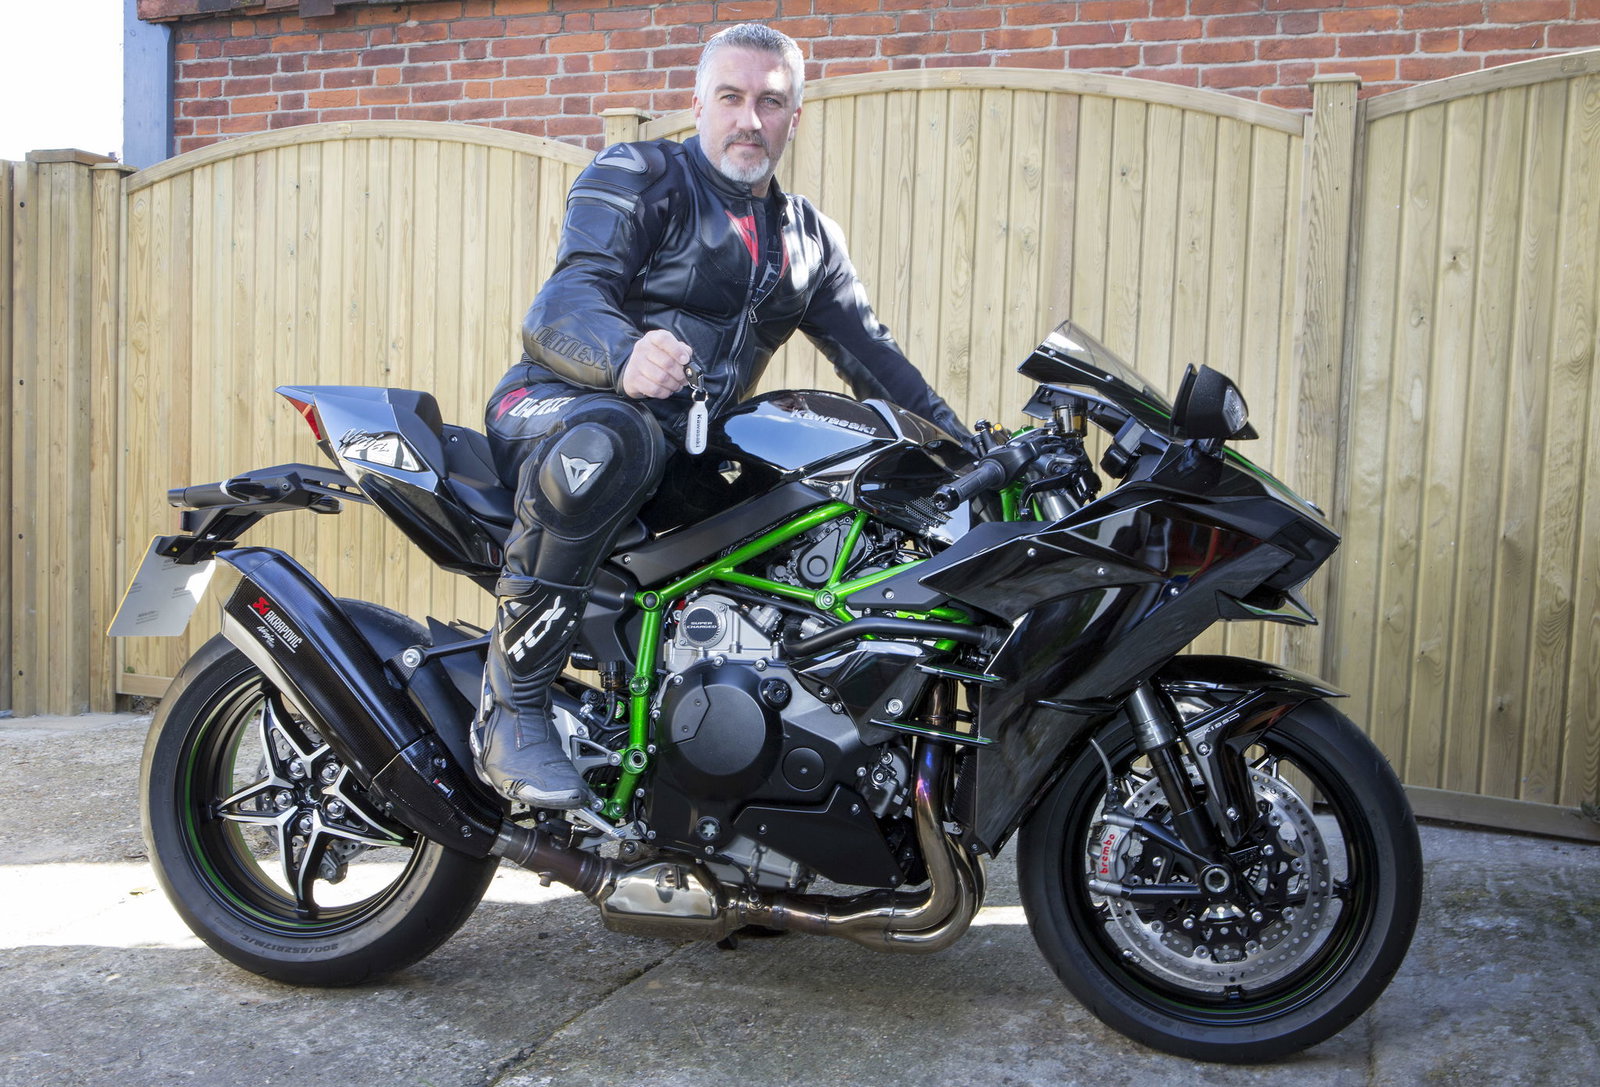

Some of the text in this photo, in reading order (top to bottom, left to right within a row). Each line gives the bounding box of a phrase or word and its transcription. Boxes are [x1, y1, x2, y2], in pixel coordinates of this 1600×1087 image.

[790, 407, 877, 435] Kawasaki
[507, 595, 567, 662] TCX
[1099, 833, 1116, 874] brembo
